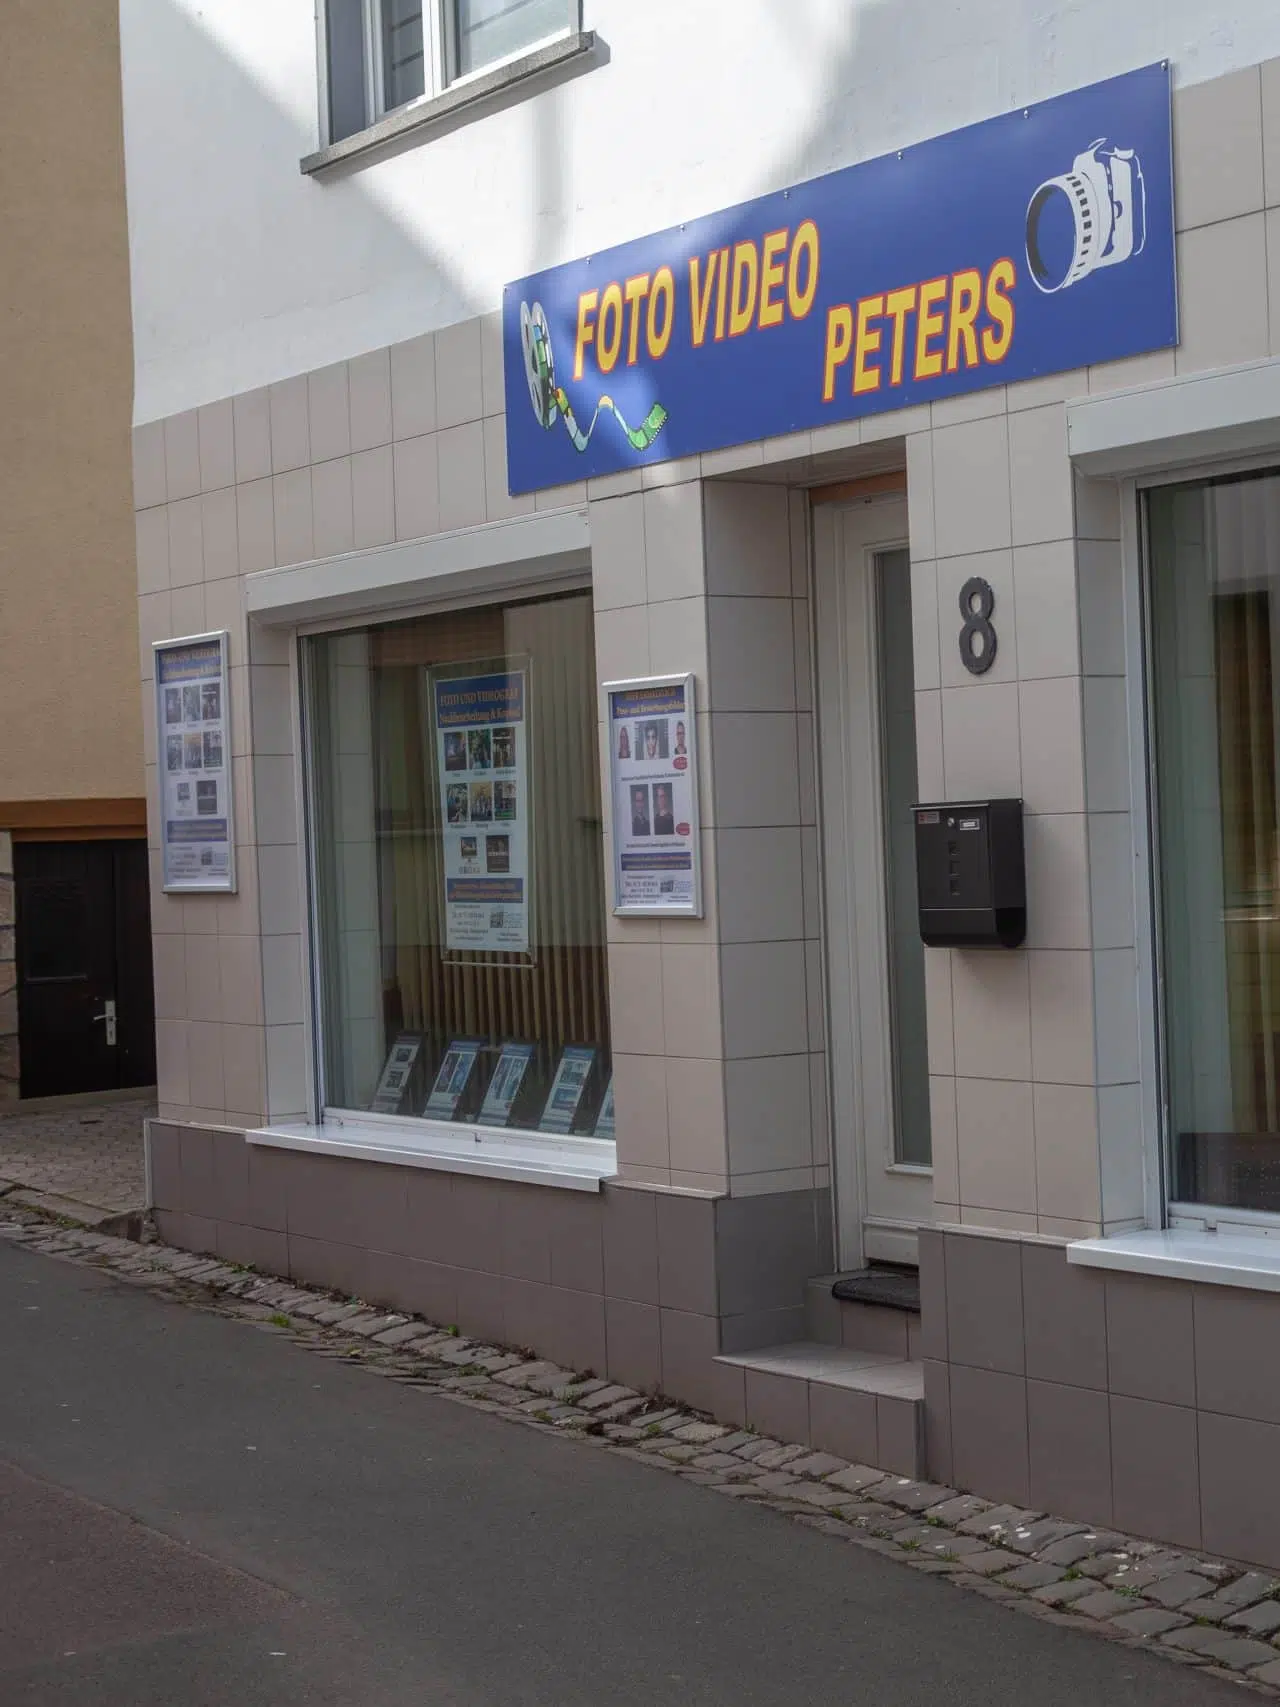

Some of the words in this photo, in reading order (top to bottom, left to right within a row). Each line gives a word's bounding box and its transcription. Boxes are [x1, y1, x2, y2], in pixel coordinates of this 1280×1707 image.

[573, 266, 675, 381] FOTO
[689, 219, 820, 348] VIDEO
[823, 257, 1016, 402] PETERS
[958, 576, 997, 675] 8
